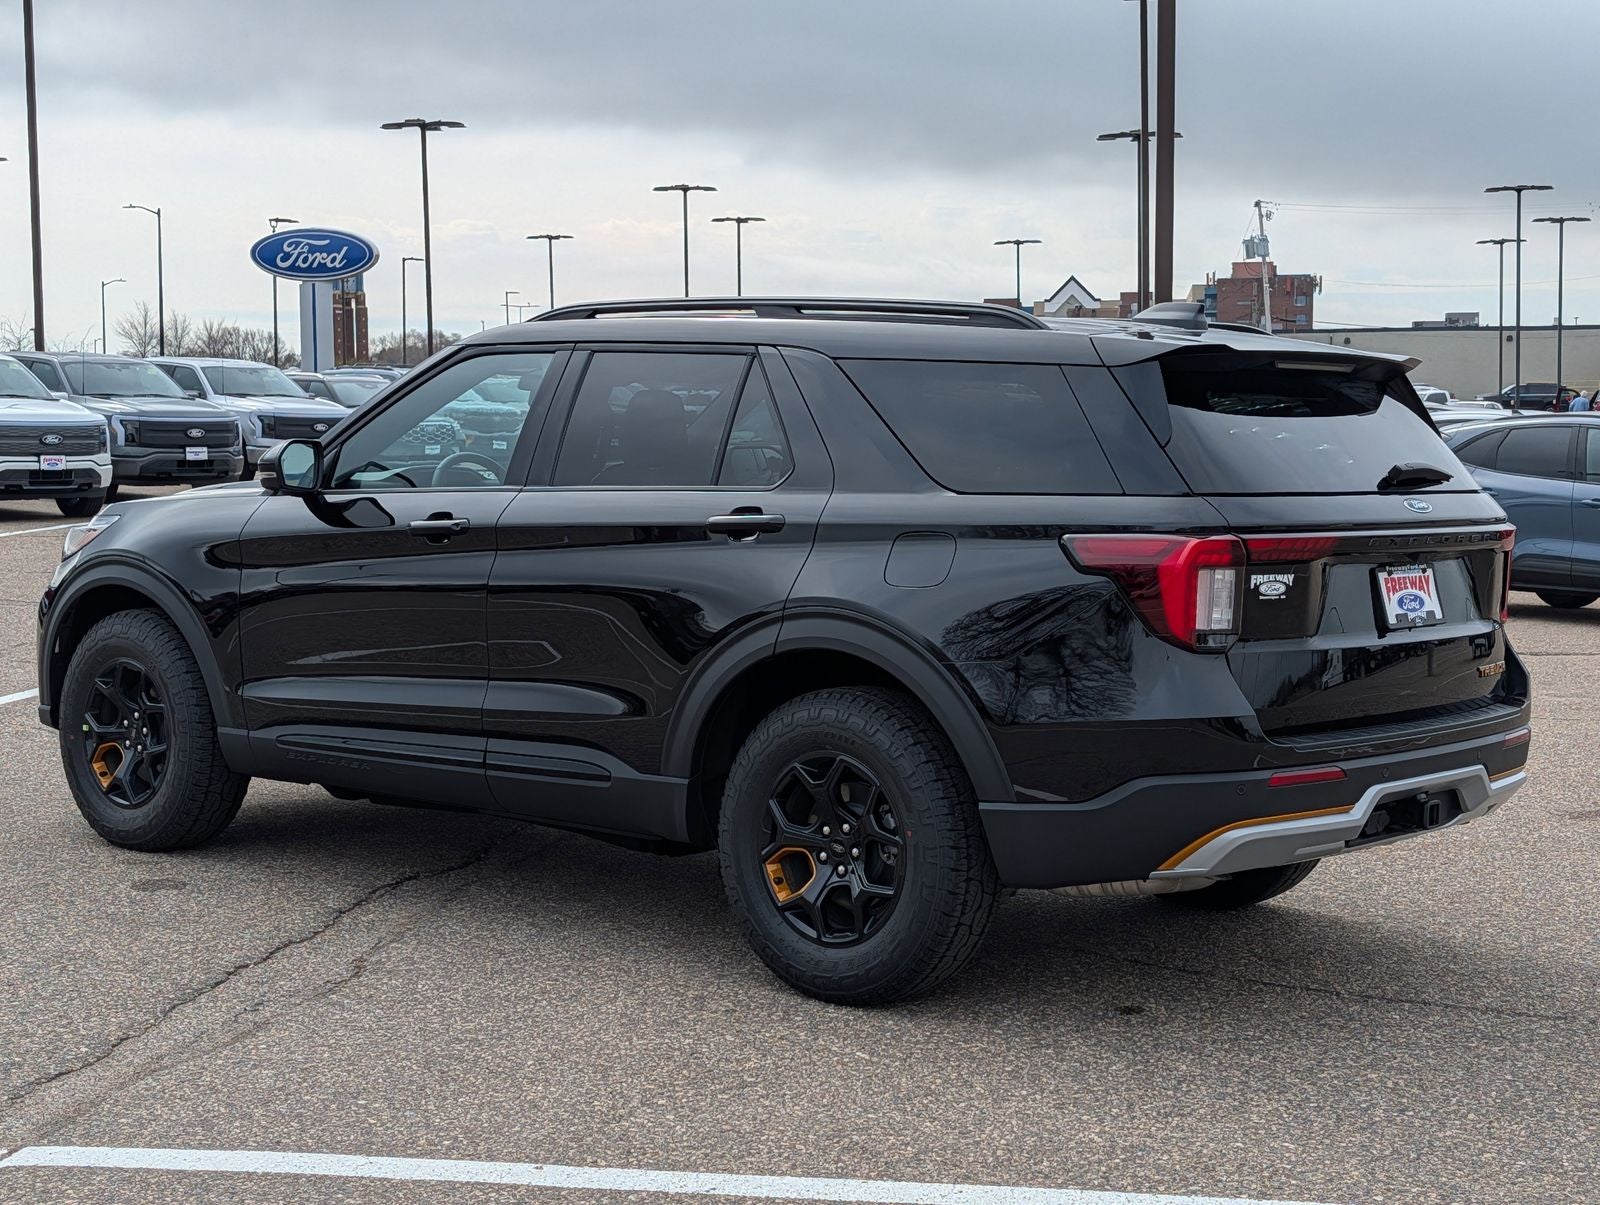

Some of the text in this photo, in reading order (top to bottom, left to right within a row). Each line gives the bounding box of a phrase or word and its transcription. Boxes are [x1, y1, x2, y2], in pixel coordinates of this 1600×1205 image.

[276, 238, 349, 268] Ford
[1250, 574, 1295, 589] FREEWAY
[1263, 584, 1282, 593] Ford
[1384, 575, 1433, 605] FREEWAY
[1402, 595, 1421, 610] Ford
